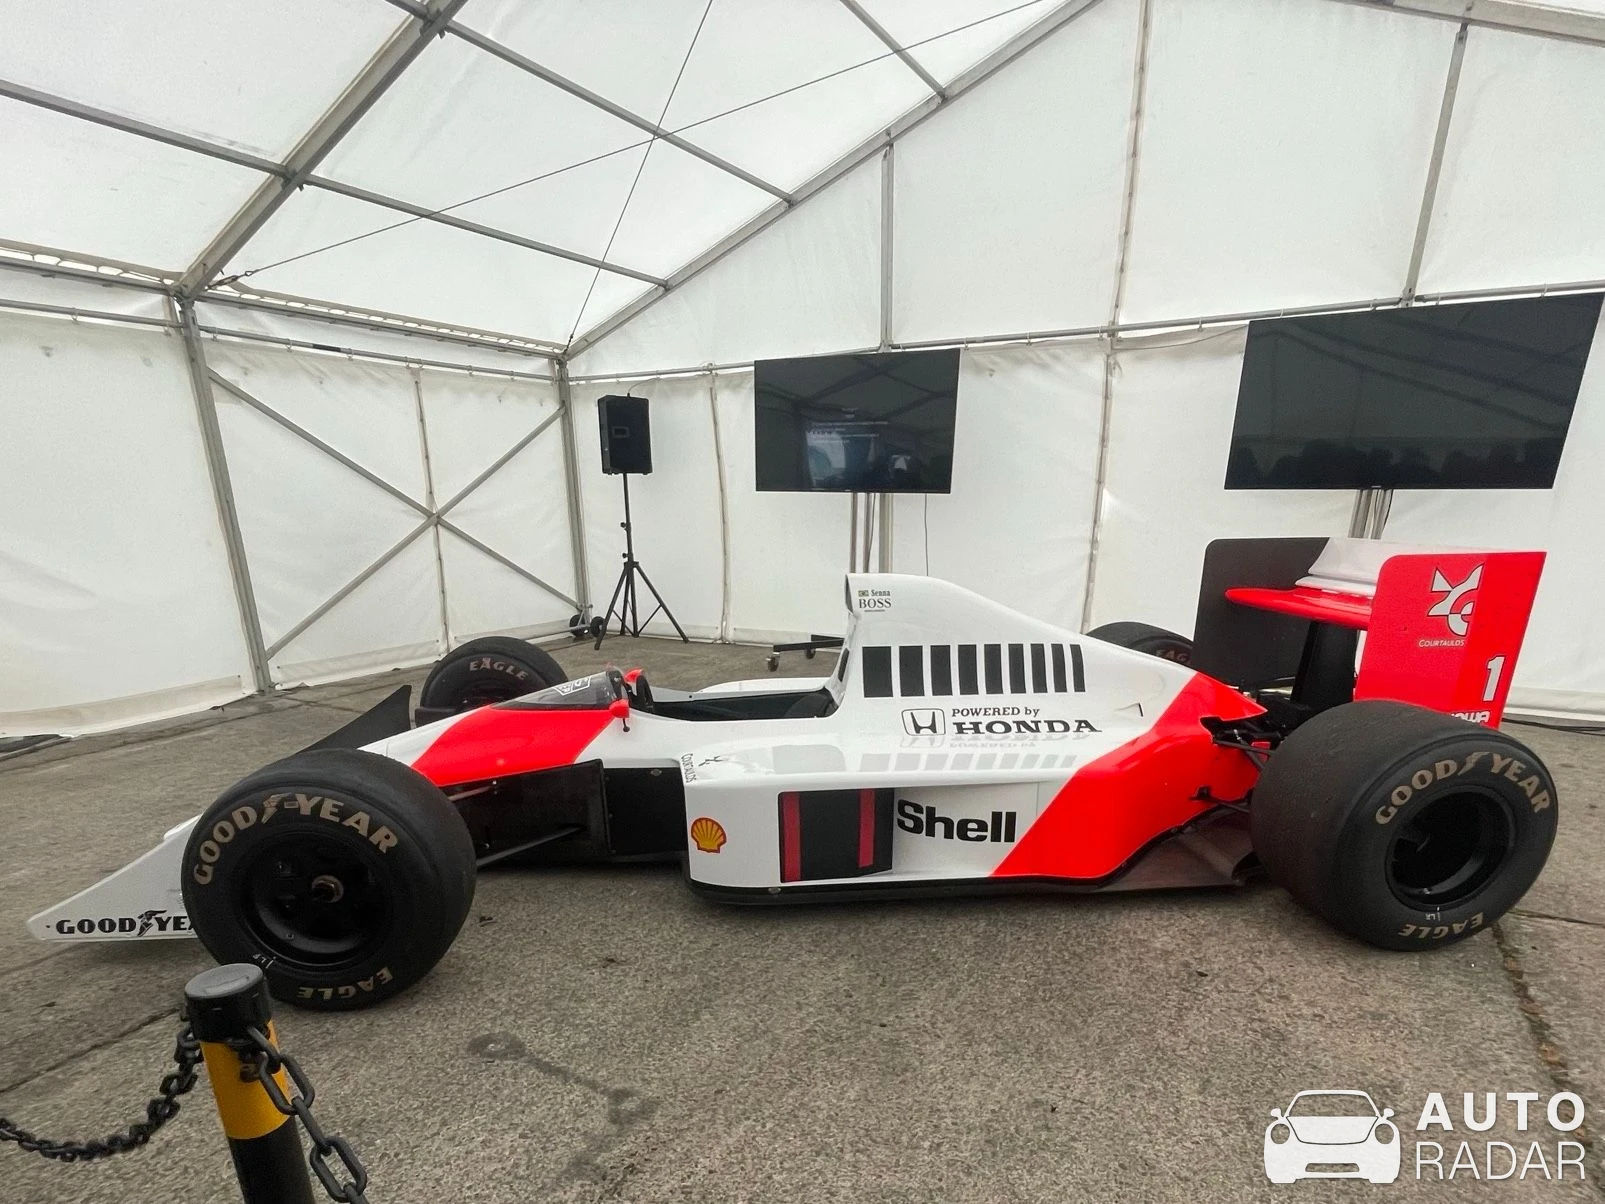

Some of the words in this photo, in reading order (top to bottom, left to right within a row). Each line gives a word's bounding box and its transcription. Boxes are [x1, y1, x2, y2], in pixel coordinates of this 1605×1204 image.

[858, 598, 892, 608] BOSS
[870, 589, 891, 597] Senna
[469, 657, 529, 680] EAGLE
[1483, 655, 1506, 702] 1
[952, 707, 1021, 717] POWERED
[1024, 707, 1040, 717] by
[952, 719, 1103, 735] HONDA
[897, 799, 1017, 843] Shell
[55, 914, 195, 936] GOODYE
[1397, 912, 1484, 940] EAGLE
[296, 966, 394, 1001] EAGLE
